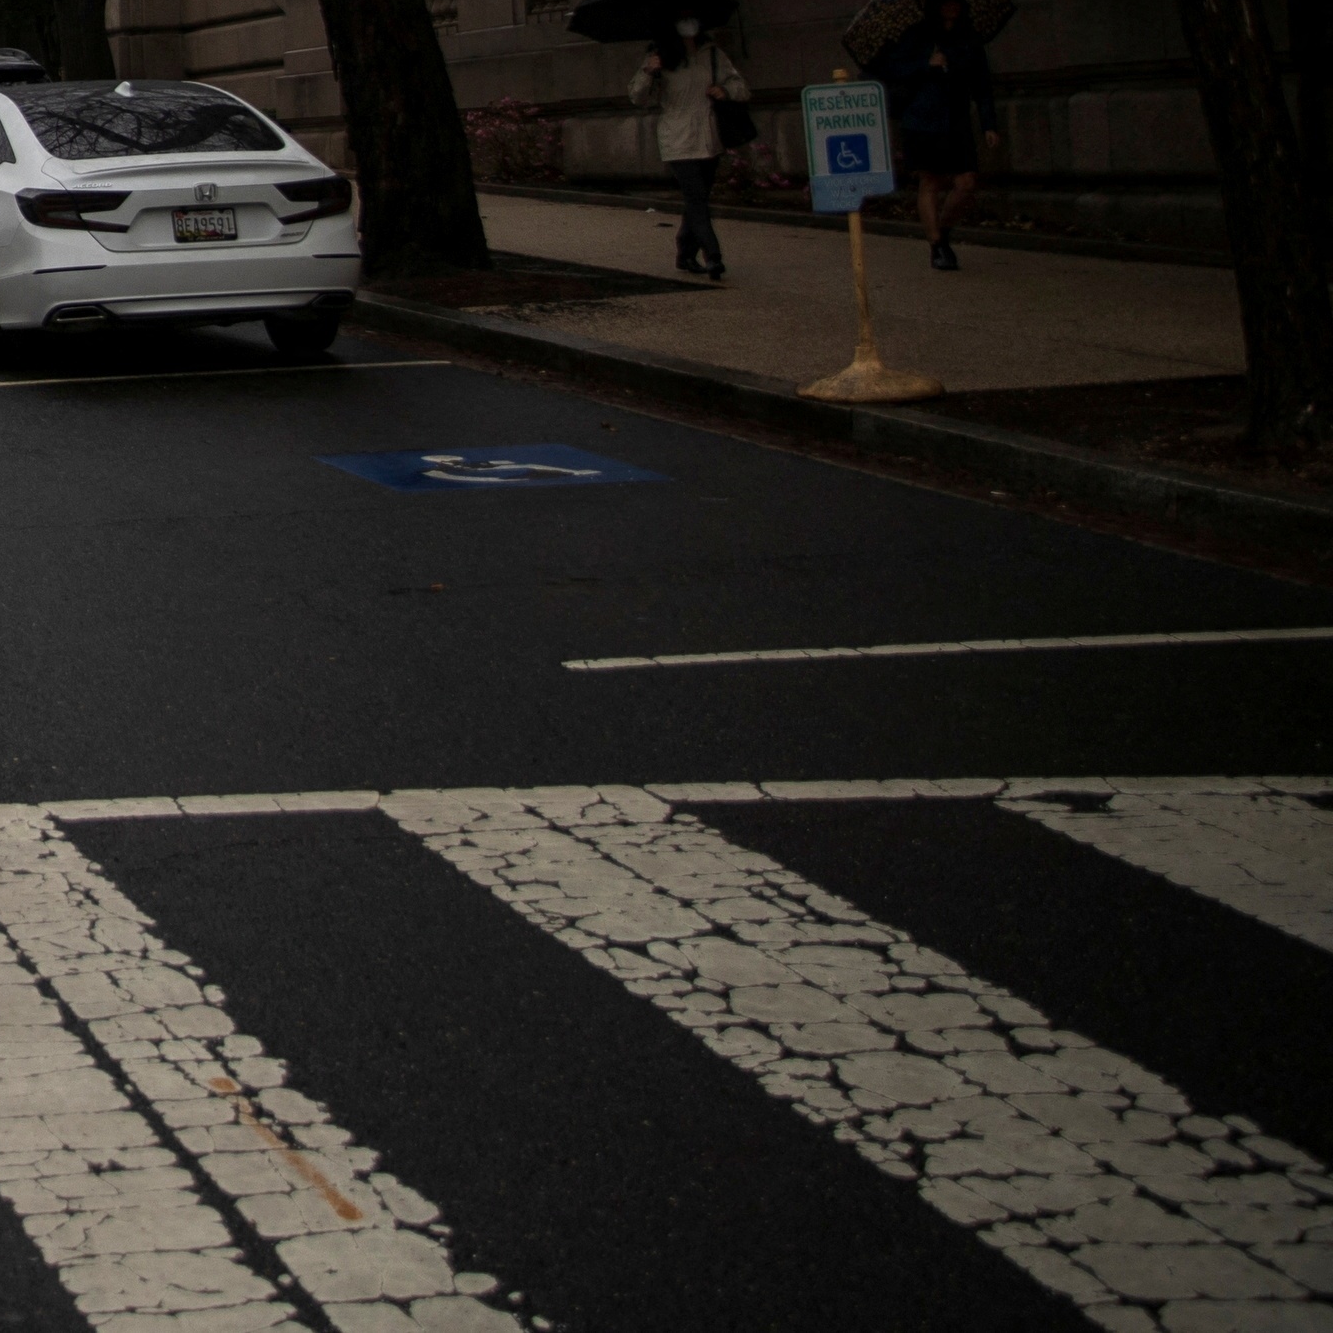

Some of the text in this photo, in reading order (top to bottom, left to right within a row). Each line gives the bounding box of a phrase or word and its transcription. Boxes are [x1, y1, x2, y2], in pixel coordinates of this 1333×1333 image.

[809, 94, 878, 111] RESERVED
[816, 113, 876, 130] PARKING
[176, 216, 231, 235] 8EA9591
